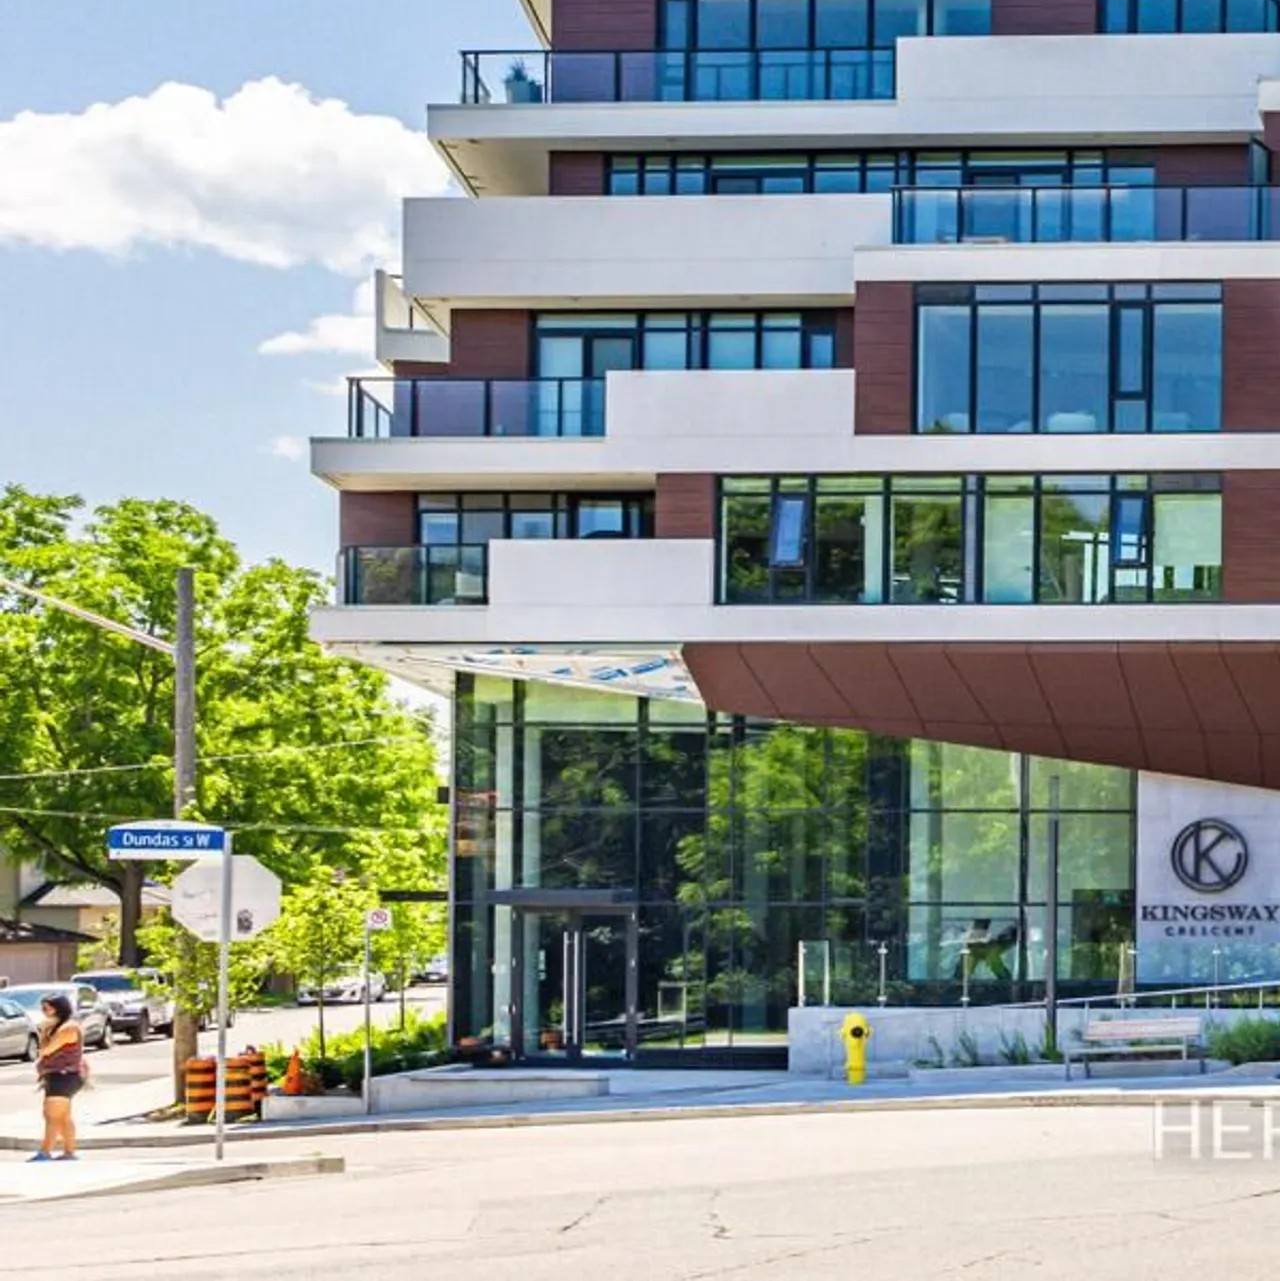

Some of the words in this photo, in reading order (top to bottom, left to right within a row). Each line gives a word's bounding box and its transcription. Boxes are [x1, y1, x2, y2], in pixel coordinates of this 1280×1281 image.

[122, 831, 178, 847] Dundas
[196, 833, 210, 848] W
[1141, 904, 1280, 922] KINGSWAY
[1165, 926, 1255, 938] CRESCENT
